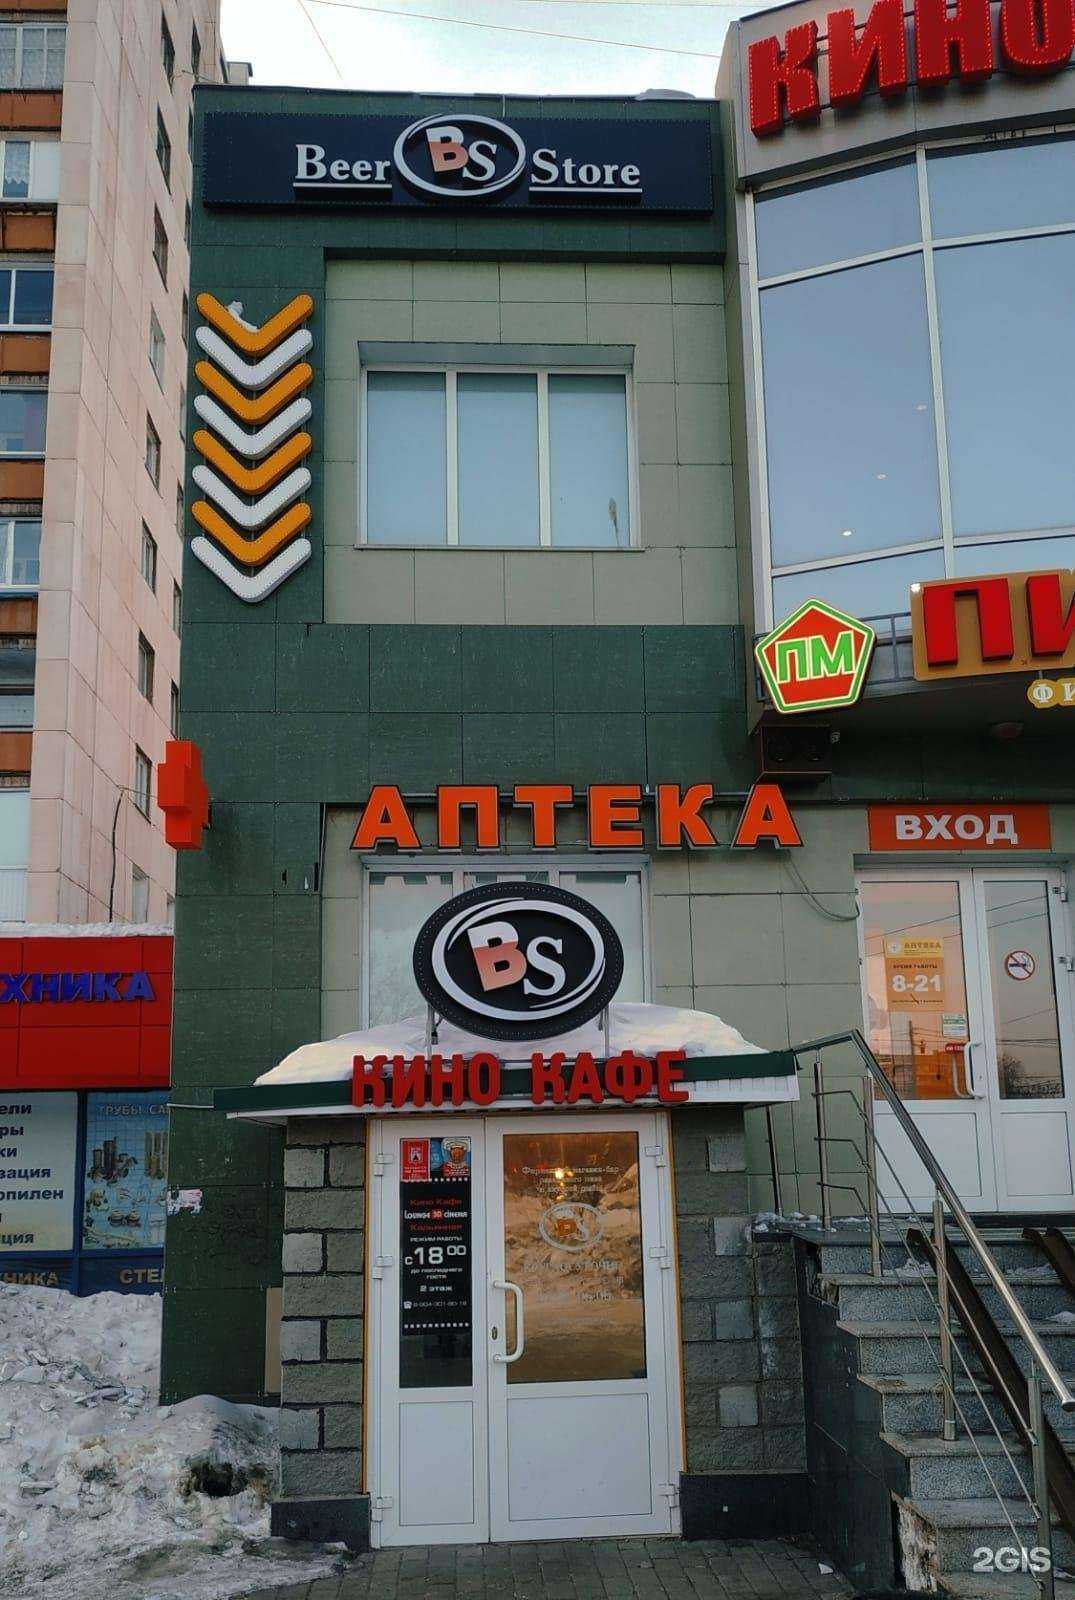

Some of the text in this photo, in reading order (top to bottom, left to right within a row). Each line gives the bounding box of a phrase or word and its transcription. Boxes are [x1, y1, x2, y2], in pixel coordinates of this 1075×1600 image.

[294, 125, 641, 187] Beer BS Store
[774, 630, 855, 684] ПМ
[350, 783, 804, 852] АПТЕКА
[894, 814, 1019, 845] ВХОД
[467, 920, 567, 997] BS
[892, 974, 941, 992] 8-21
[351, 1049, 690, 1108] КИНО КАФЕ
[119, 1268, 164, 1284] СТЕ
